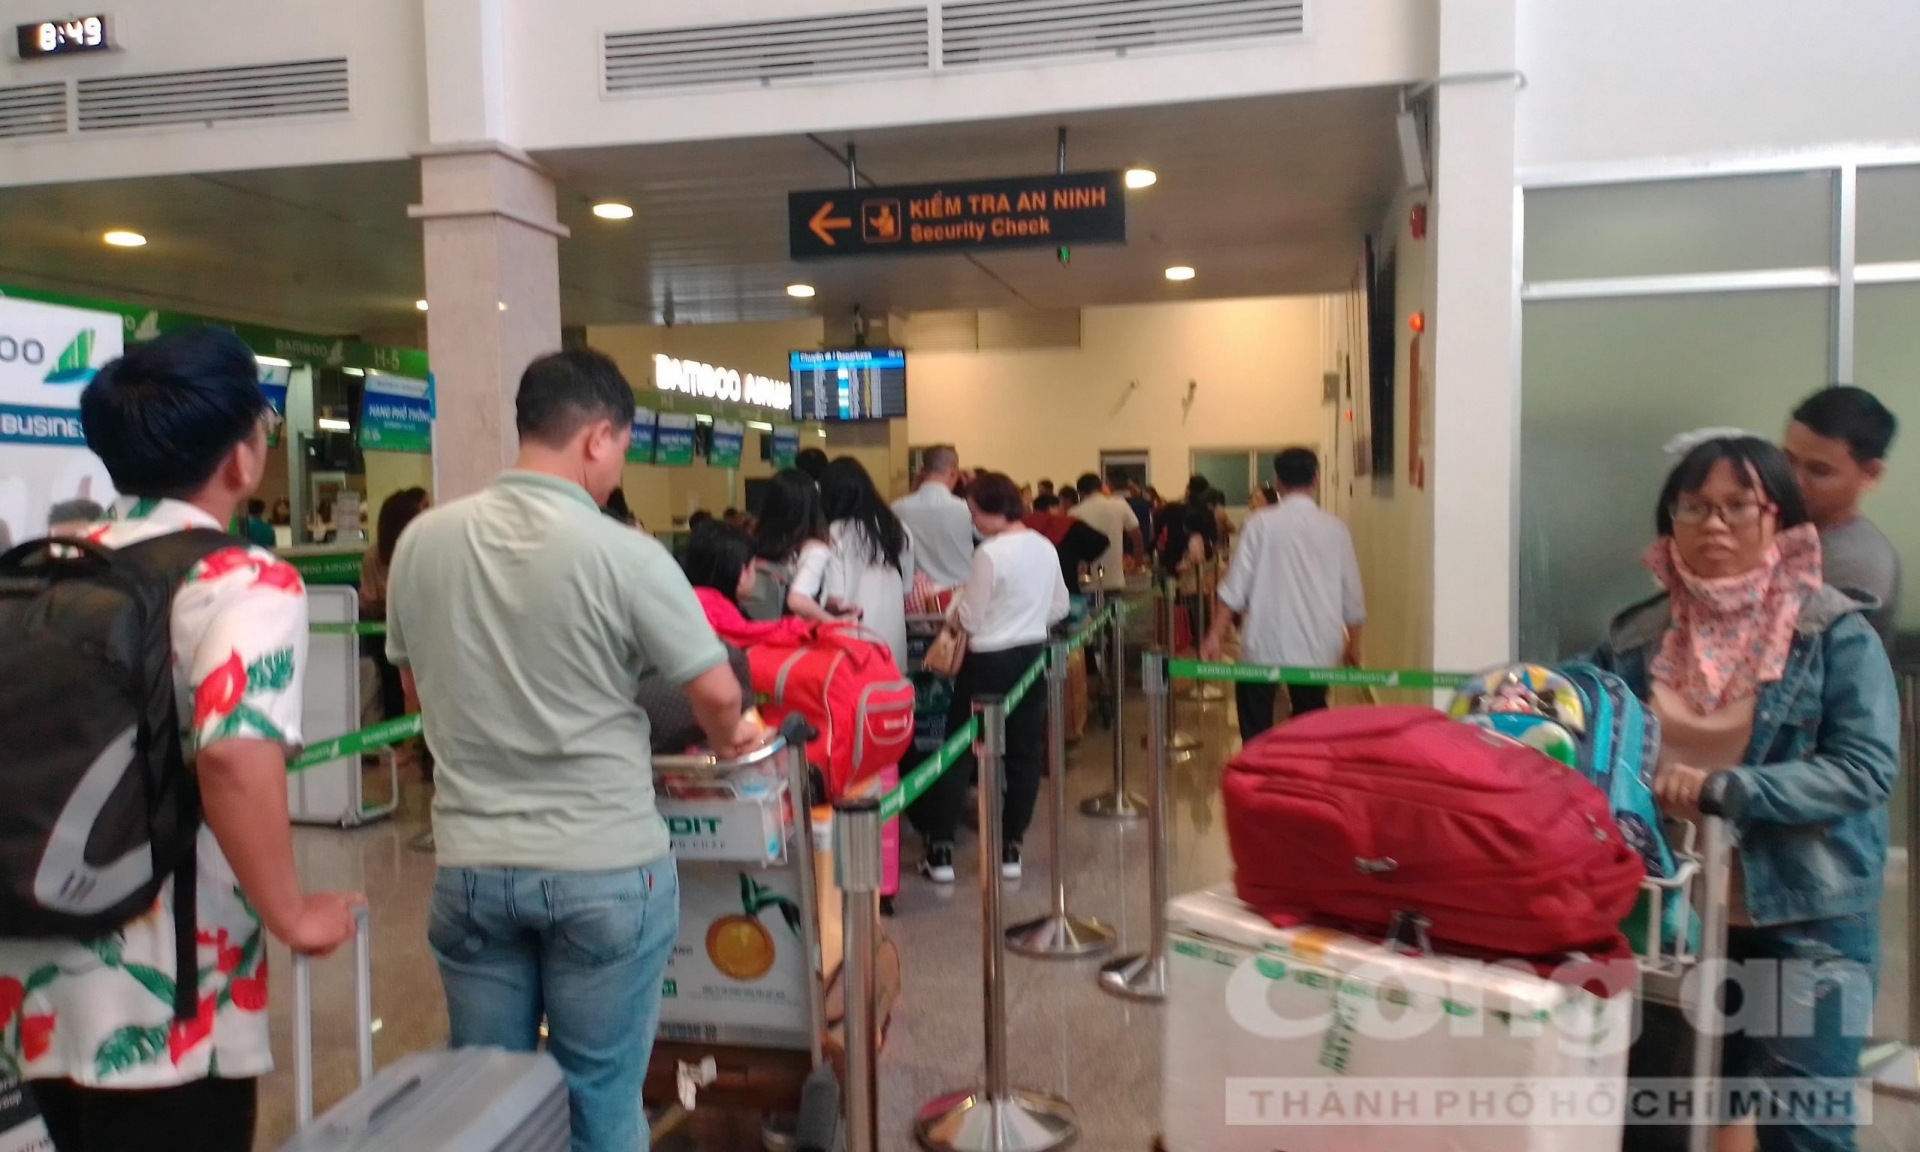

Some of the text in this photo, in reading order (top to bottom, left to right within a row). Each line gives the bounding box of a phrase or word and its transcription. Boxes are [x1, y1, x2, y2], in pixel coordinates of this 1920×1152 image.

[39, 16, 101, 51] 8:49
[967, 191, 1011, 214] TRA
[1017, 189, 1046, 212] AN
[1053, 185, 1106, 210] NINH
[911, 215, 1050, 243] Security Check
[656, 353, 741, 402] BAMBOO
[664, 815, 722, 835] DIT
